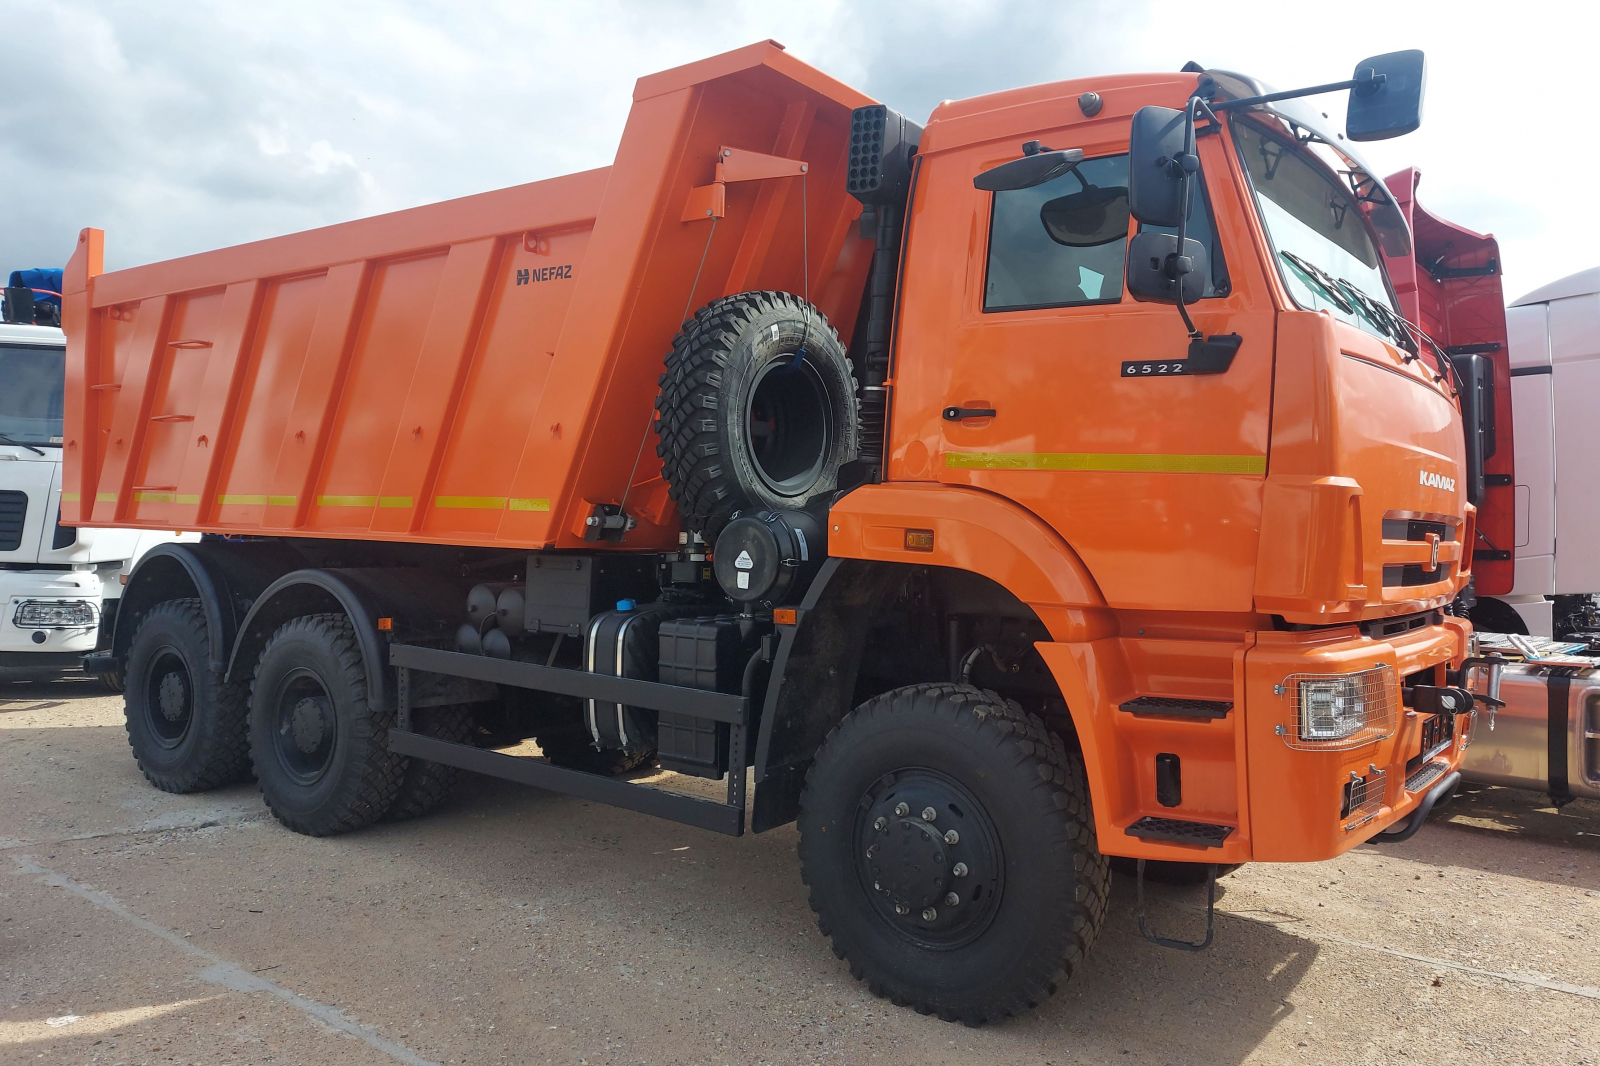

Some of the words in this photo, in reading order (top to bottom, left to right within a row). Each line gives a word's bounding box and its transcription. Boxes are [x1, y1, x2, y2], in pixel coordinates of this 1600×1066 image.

[532, 265, 572, 282] NEFAZ
[1126, 363, 1183, 374] 6522
[1419, 470, 1456, 493] KAMAZ
